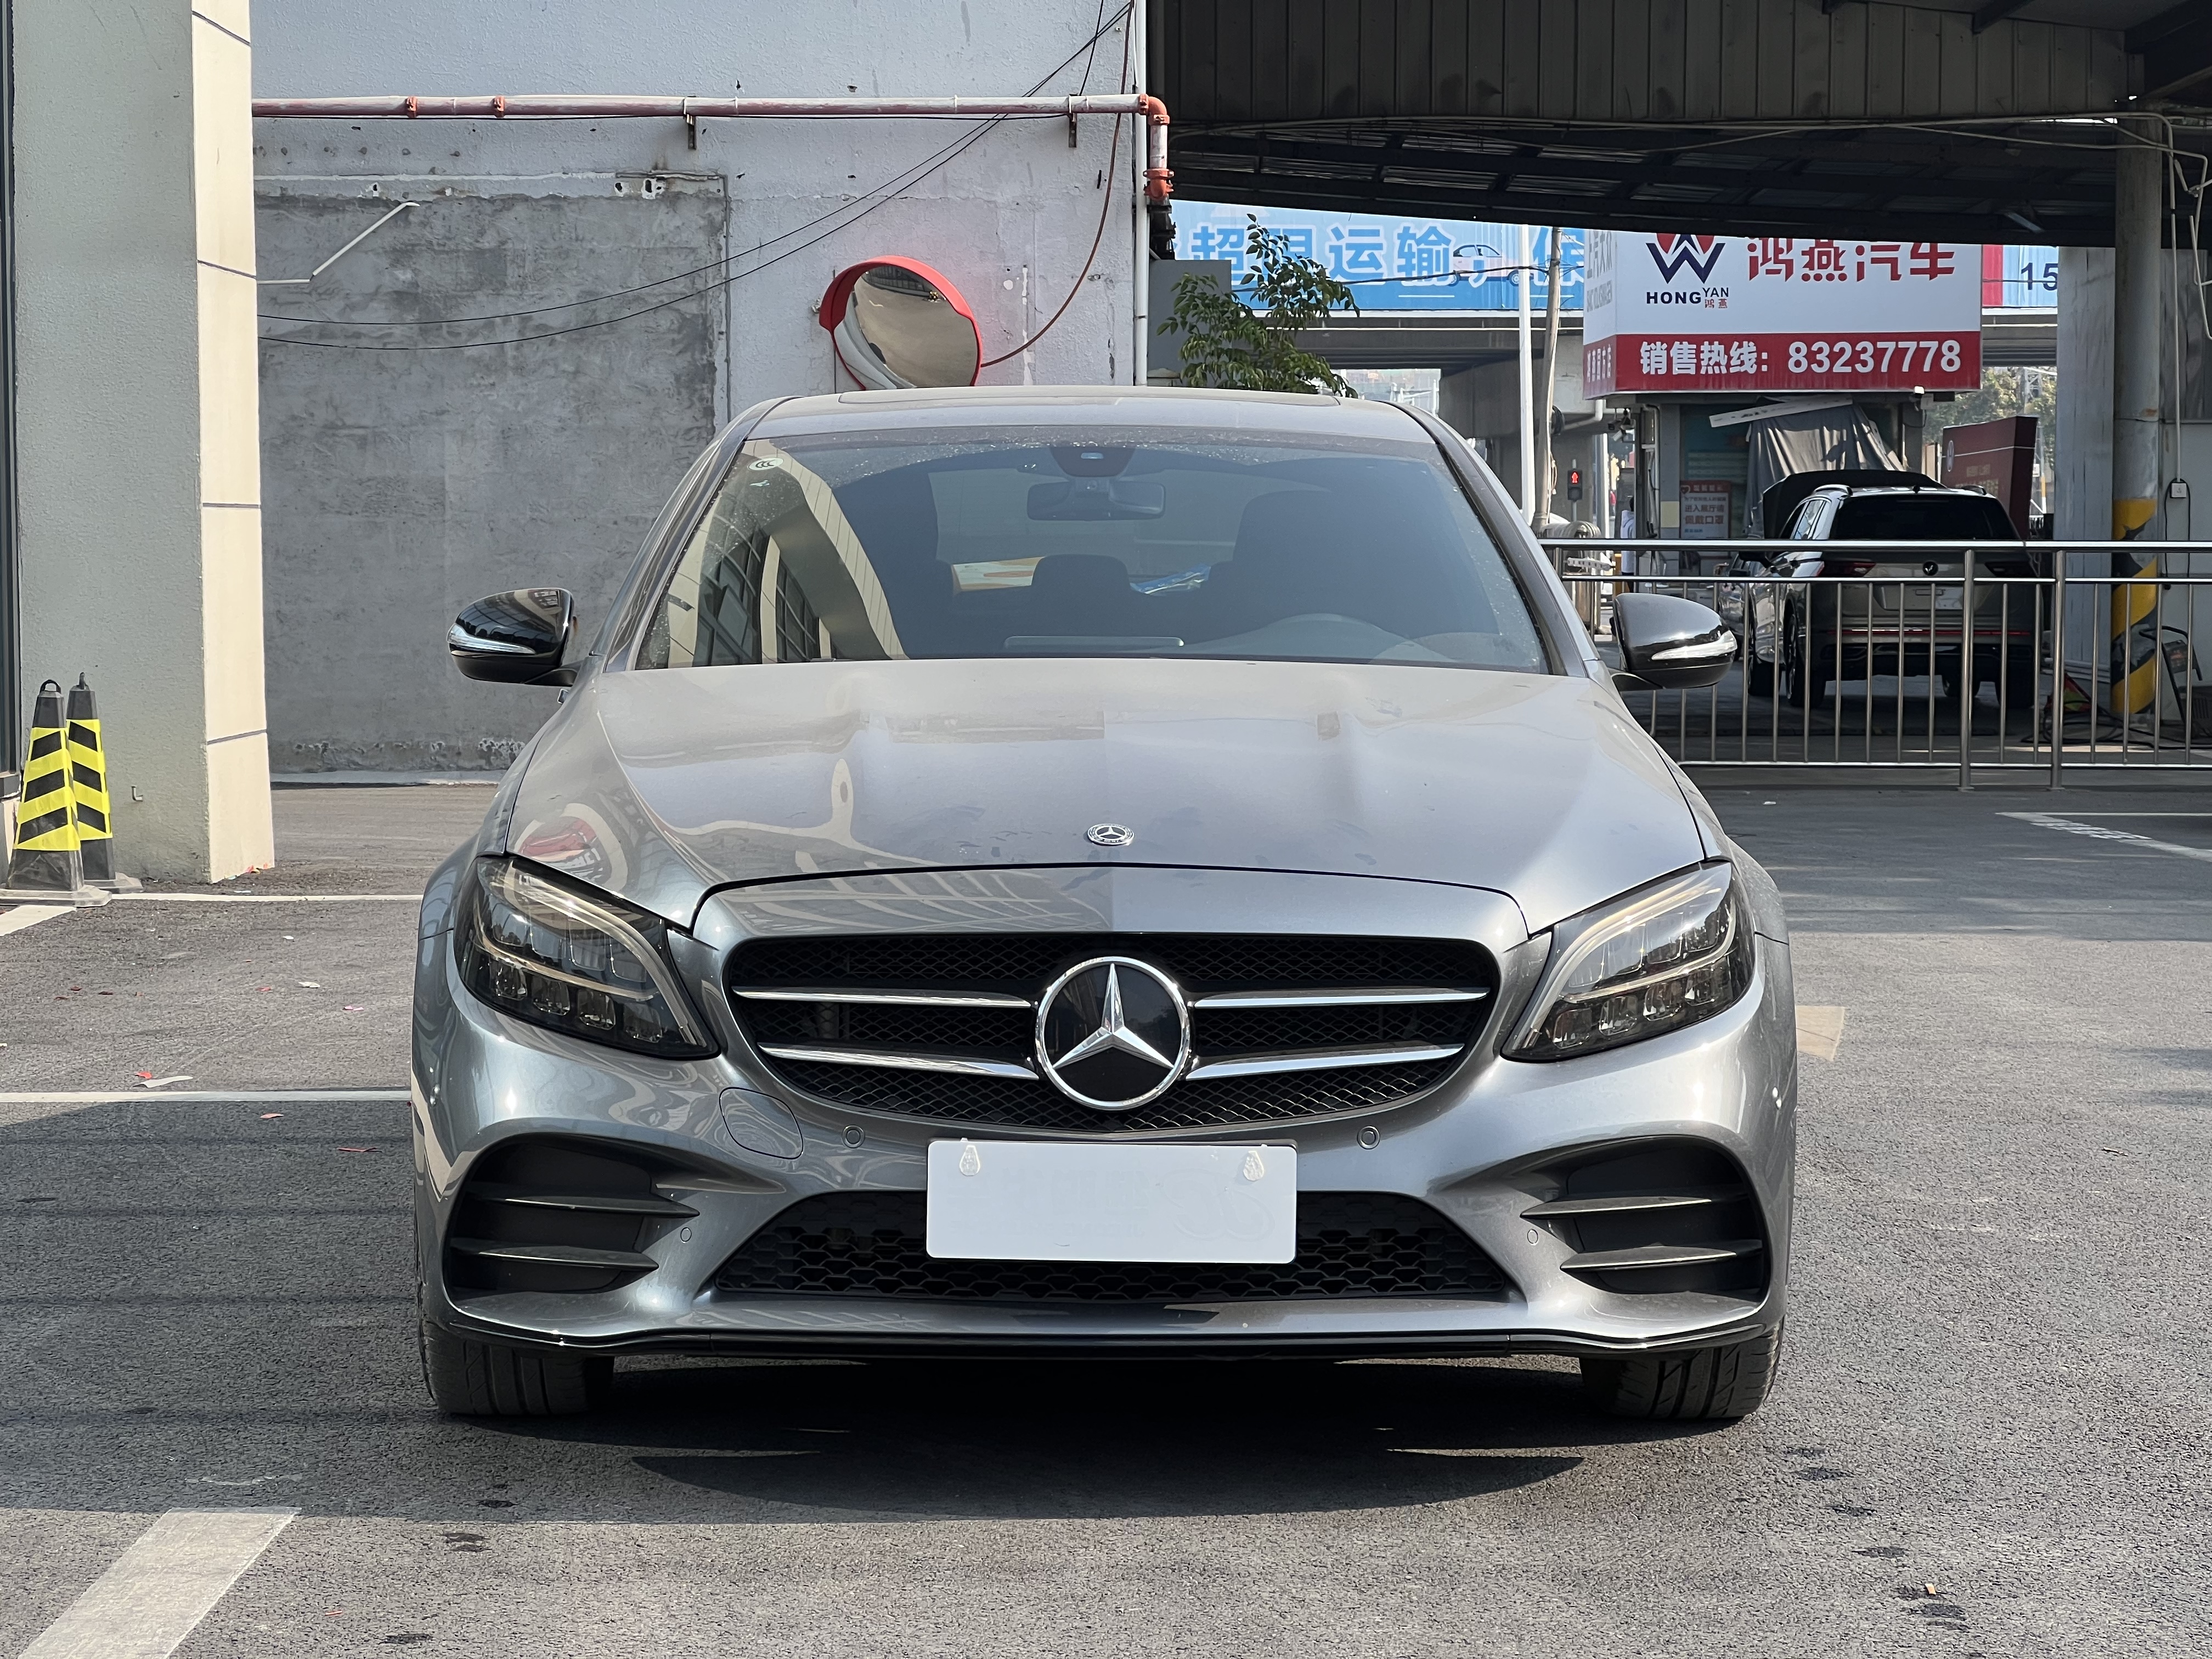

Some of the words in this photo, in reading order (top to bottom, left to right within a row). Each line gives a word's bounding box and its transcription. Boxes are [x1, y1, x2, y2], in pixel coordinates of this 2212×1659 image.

[1646, 291, 1701, 304] HONG
[1702, 287, 1729, 297] YAN
[1788, 340, 1961, 374] 83237778
